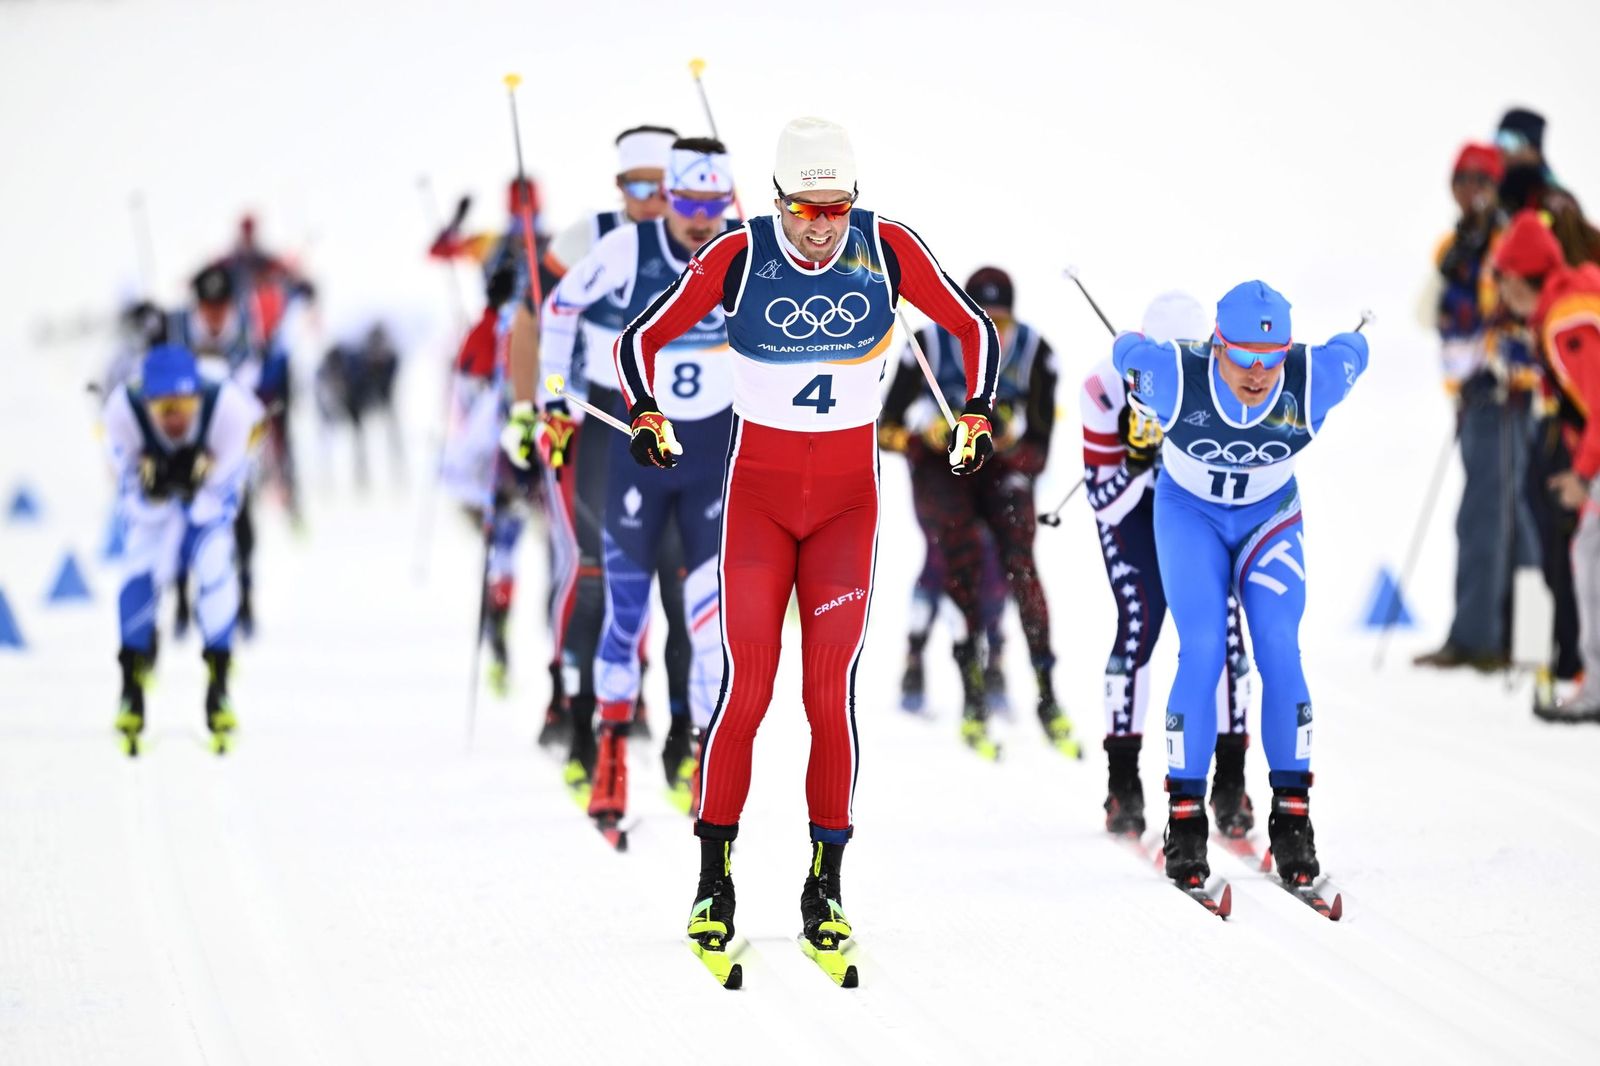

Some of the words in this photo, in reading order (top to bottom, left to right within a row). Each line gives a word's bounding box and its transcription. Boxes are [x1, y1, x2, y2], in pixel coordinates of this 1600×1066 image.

[800, 168, 837, 177] NORGE
[757, 343, 804, 353] MILANO
[806, 343, 856, 352] CORTINA
[857, 335, 875, 348] 2026
[671, 362, 701, 398] 8
[792, 374, 837, 414] 4
[967, 419, 984, 440] LEKI
[1207, 469, 1250, 500] 11
[814, 591, 855, 616] CRAFT
